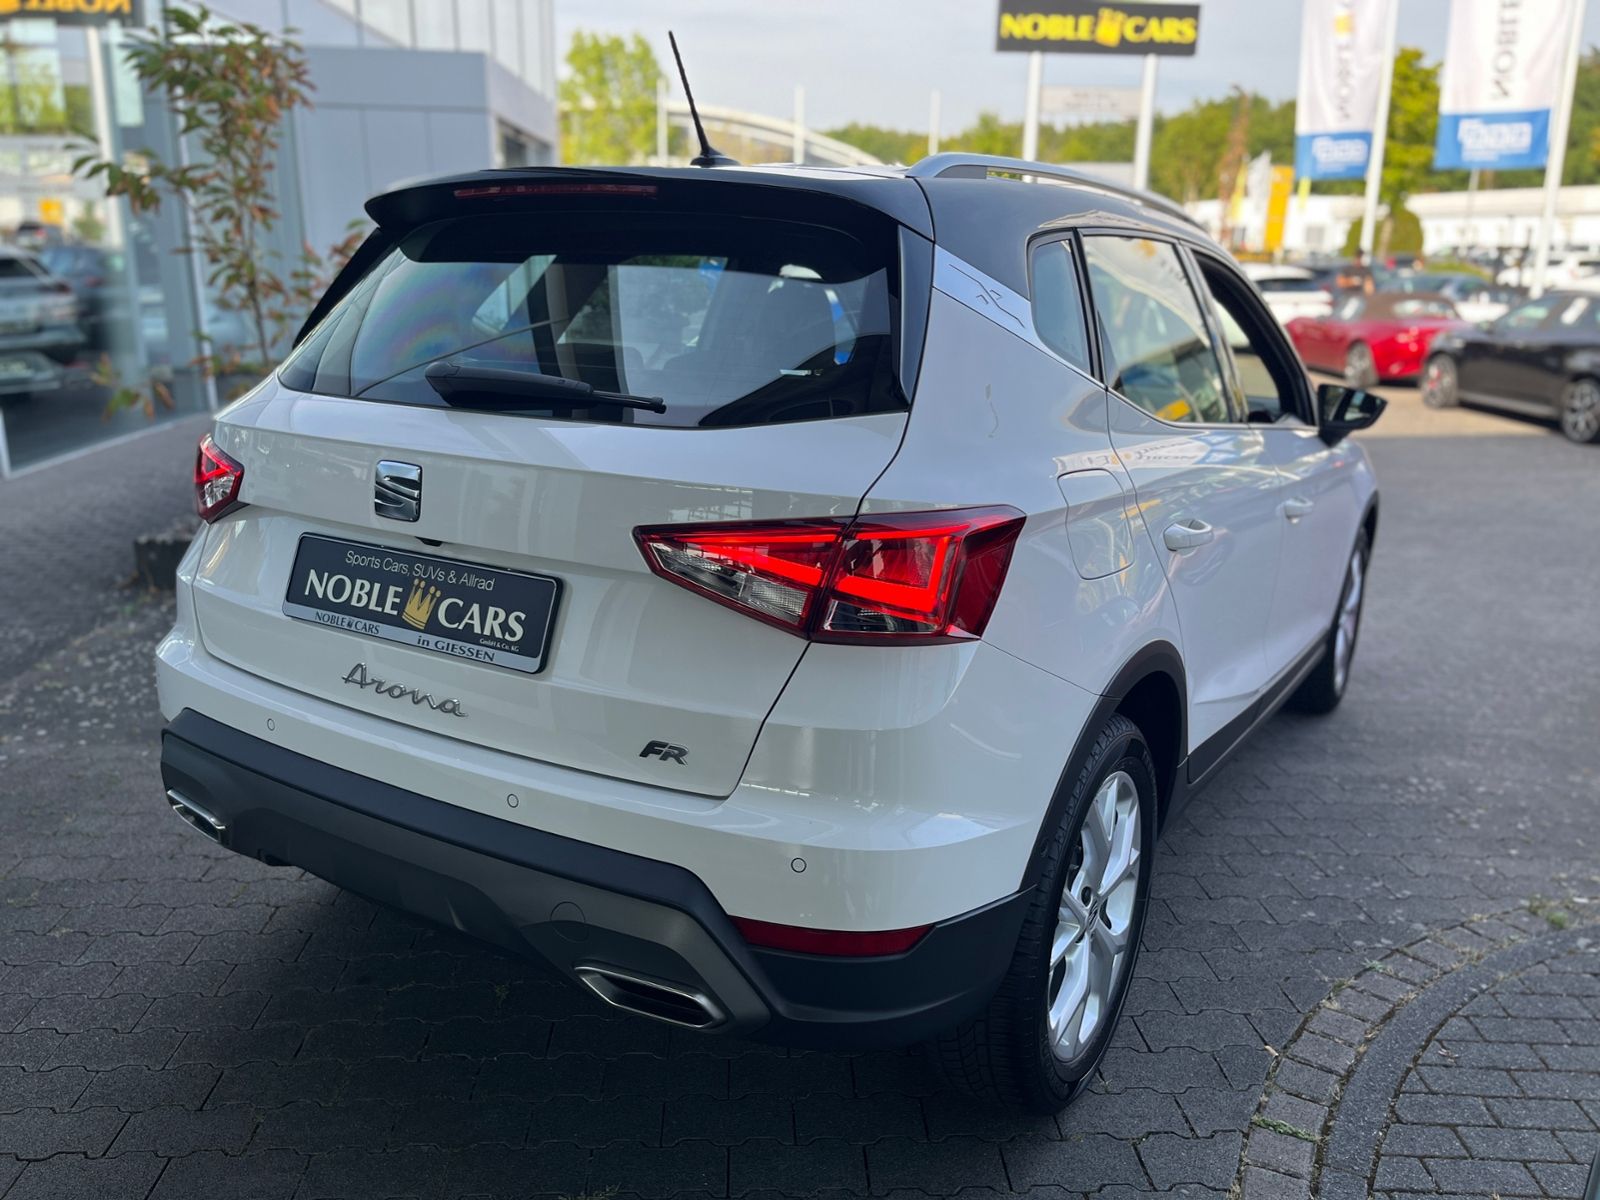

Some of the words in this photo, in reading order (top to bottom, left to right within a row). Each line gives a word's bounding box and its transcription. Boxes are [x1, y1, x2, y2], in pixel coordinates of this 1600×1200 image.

[1001, 13, 1095, 41] NOBLE
[1123, 16, 1197, 44] CARS
[345, 550, 381, 569] Sports
[383, 557, 410, 576] Cars,
[412, 563, 445, 581] SUVs
[447, 570, 457, 584] &
[459, 573, 495, 591] Allrad
[304, 568, 404, 616] NOBLE
[437, 597, 527, 642] CARS
[315, 611, 348, 628] NOBLE
[354, 620, 380, 635] CARS
[417, 635, 430, 646] in
[434, 640, 496, 661] GIESSEN
[341, 662, 469, 717] Arona
[639, 740, 688, 767] FR
